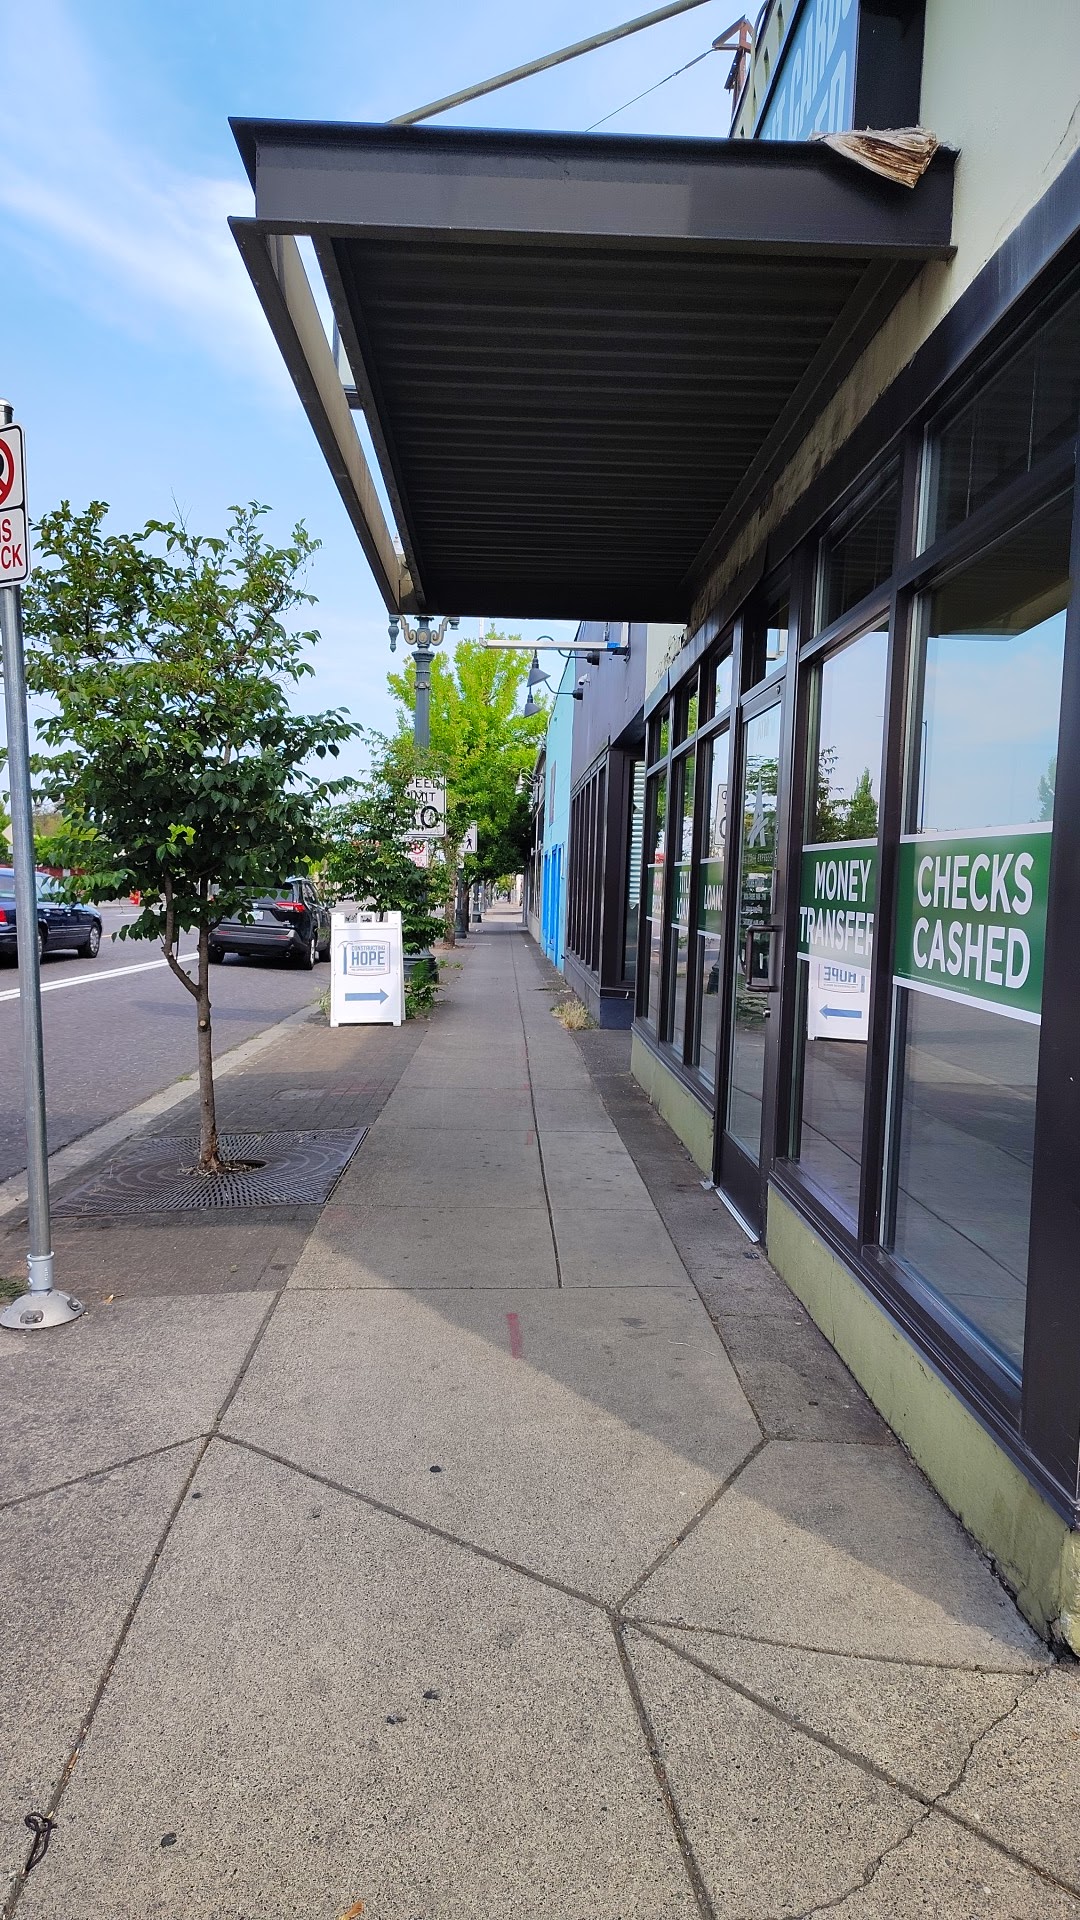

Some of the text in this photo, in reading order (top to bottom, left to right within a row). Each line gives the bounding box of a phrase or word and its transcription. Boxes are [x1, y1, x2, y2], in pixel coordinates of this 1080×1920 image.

[814, 859, 872, 903] MONEY
[917, 852, 1034, 915] CHECKS
[351, 951, 386, 966] HOPE
[913, 917, 1031, 989] CASHED
